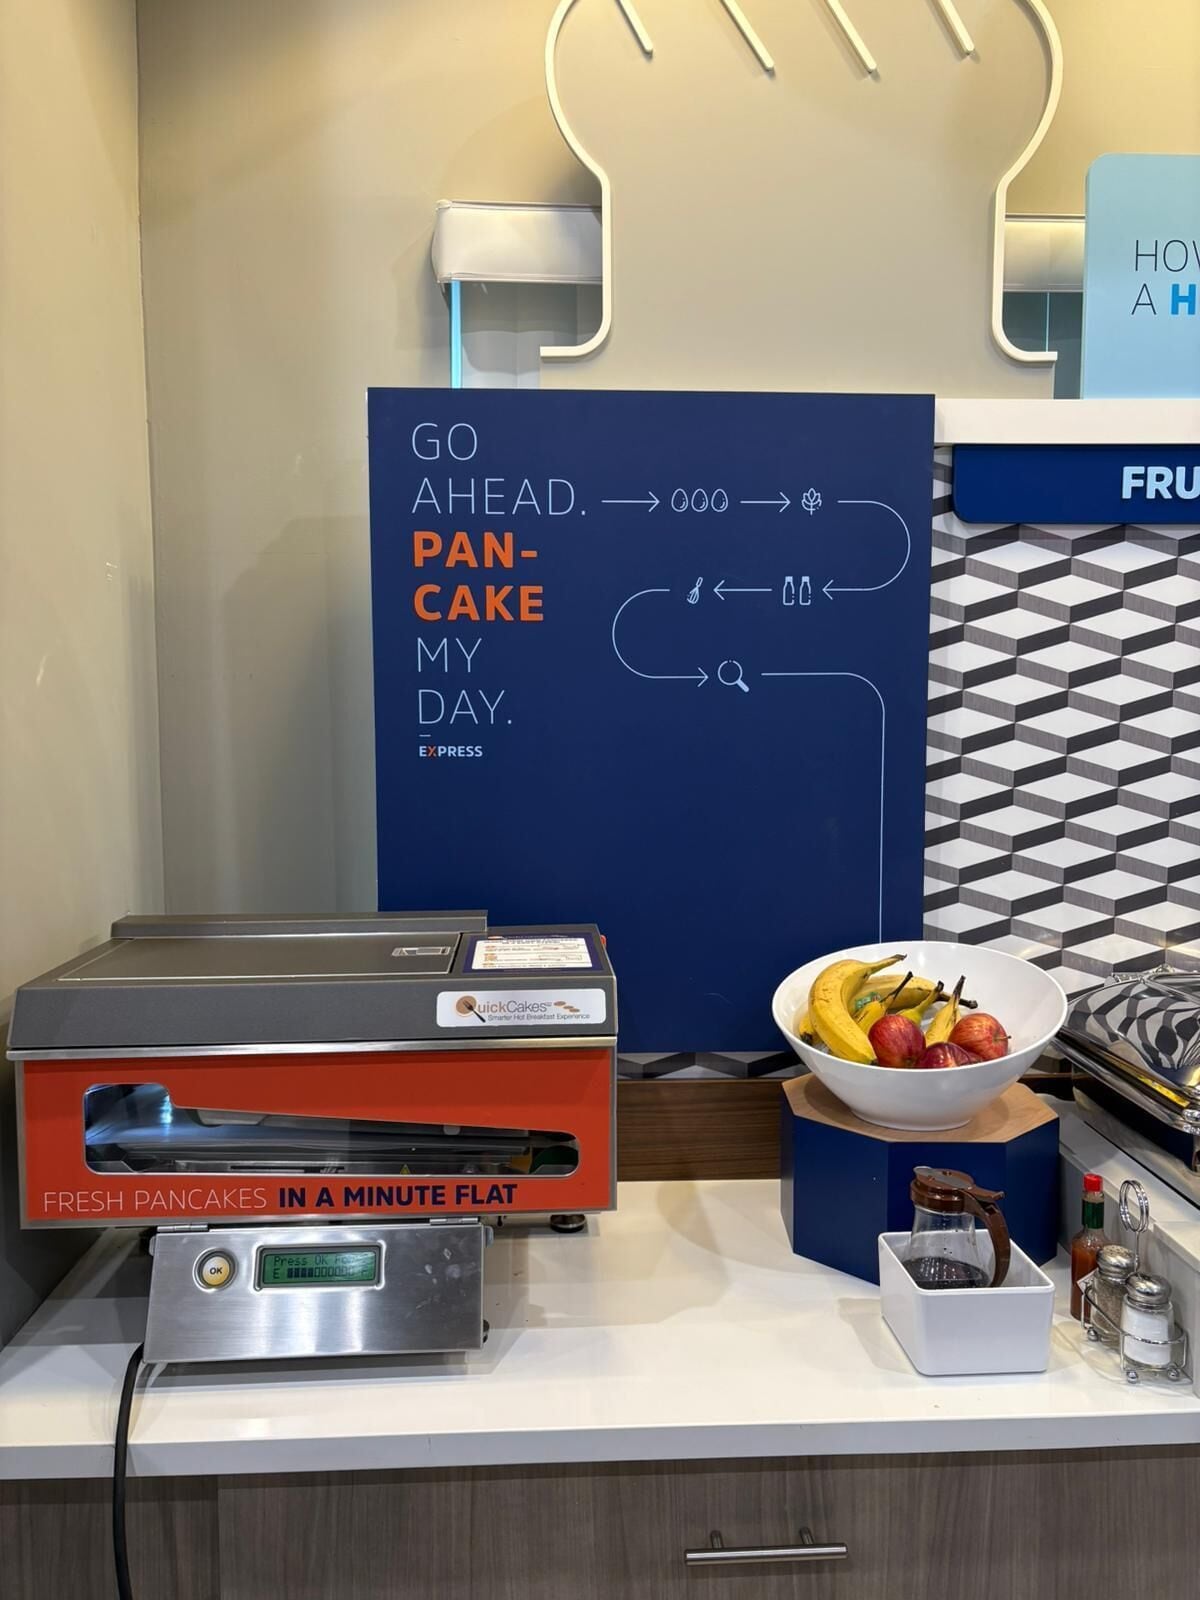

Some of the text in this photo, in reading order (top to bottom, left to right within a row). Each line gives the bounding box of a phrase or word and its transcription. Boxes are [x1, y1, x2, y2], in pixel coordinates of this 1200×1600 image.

[1131, 283, 1157, 315] A
[411, 422, 478, 461] GO
[411, 477, 586, 516] AHEAD.
[1122, 465, 1200, 500] FRU
[413, 531, 538, 569] PAN-
[413, 583, 544, 622] CAKE
[417, 637, 482, 673] MY
[418, 688, 512, 725] DAY.
[419, 745, 483, 758] EXPRESS
[487, 1012, 590, 1021] Smarter Hot Breakfast Experience
[44, 1184, 518, 1212] FRESH PANCAKES IN A MINUTE FLAT
[210, 1267, 223, 1275] OK
[273, 1255, 307, 1266] Press
